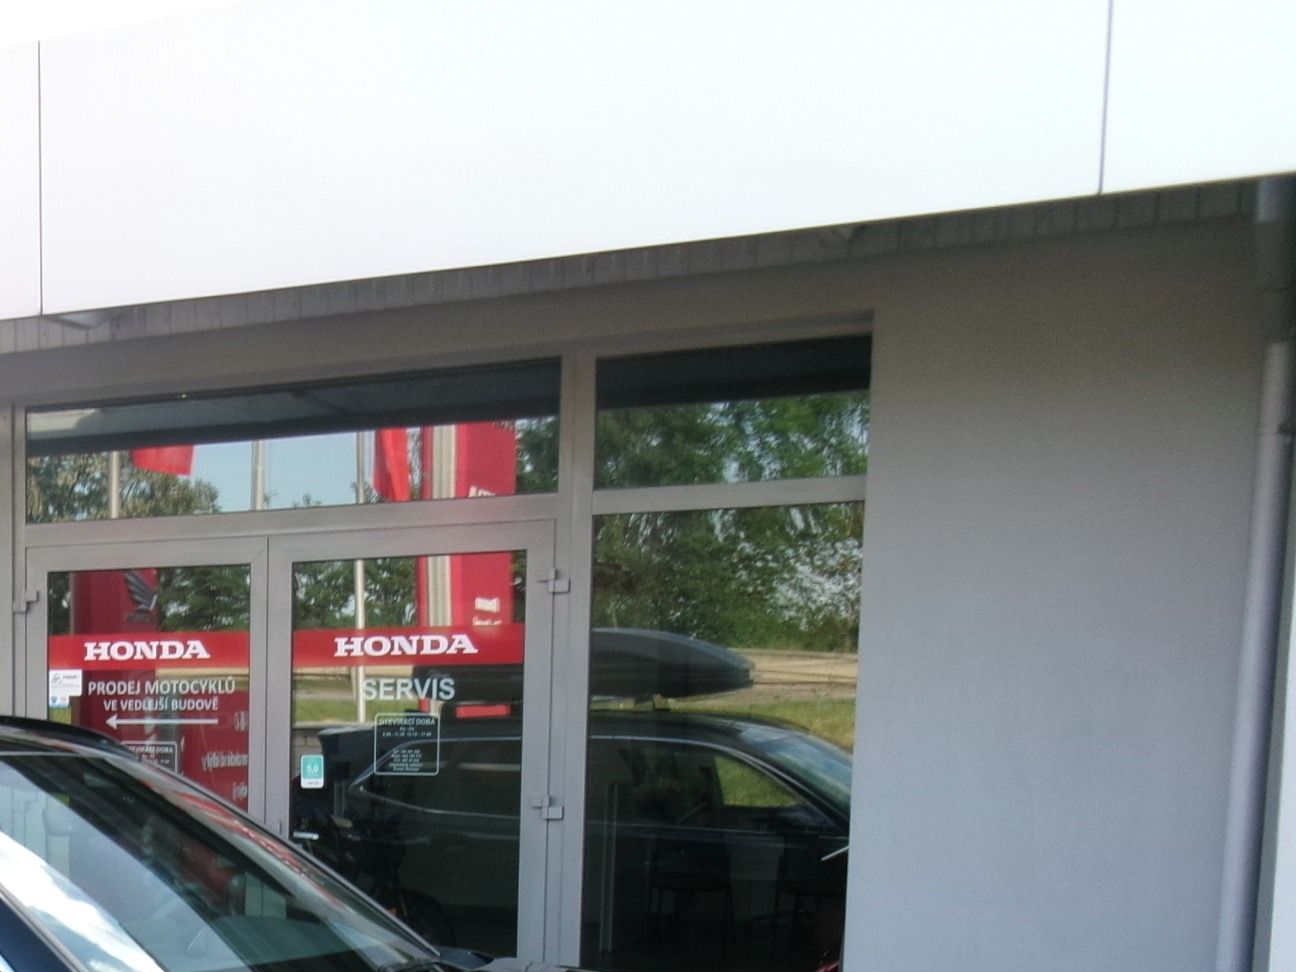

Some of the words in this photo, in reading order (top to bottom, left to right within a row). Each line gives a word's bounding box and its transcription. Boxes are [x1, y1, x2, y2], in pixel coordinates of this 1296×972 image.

[84, 640, 211, 661] HONDA
[334, 634, 479, 657] HONDA
[88, 680, 141, 696] PRODEJ
[145, 676, 236, 695] MOTOCYKLŮ
[361, 678, 456, 700] SERVIS
[104, 700, 117, 711] VE
[120, 697, 169, 711] VEDLEJŠÍ
[171, 697, 219, 711] BUDOVĚ
